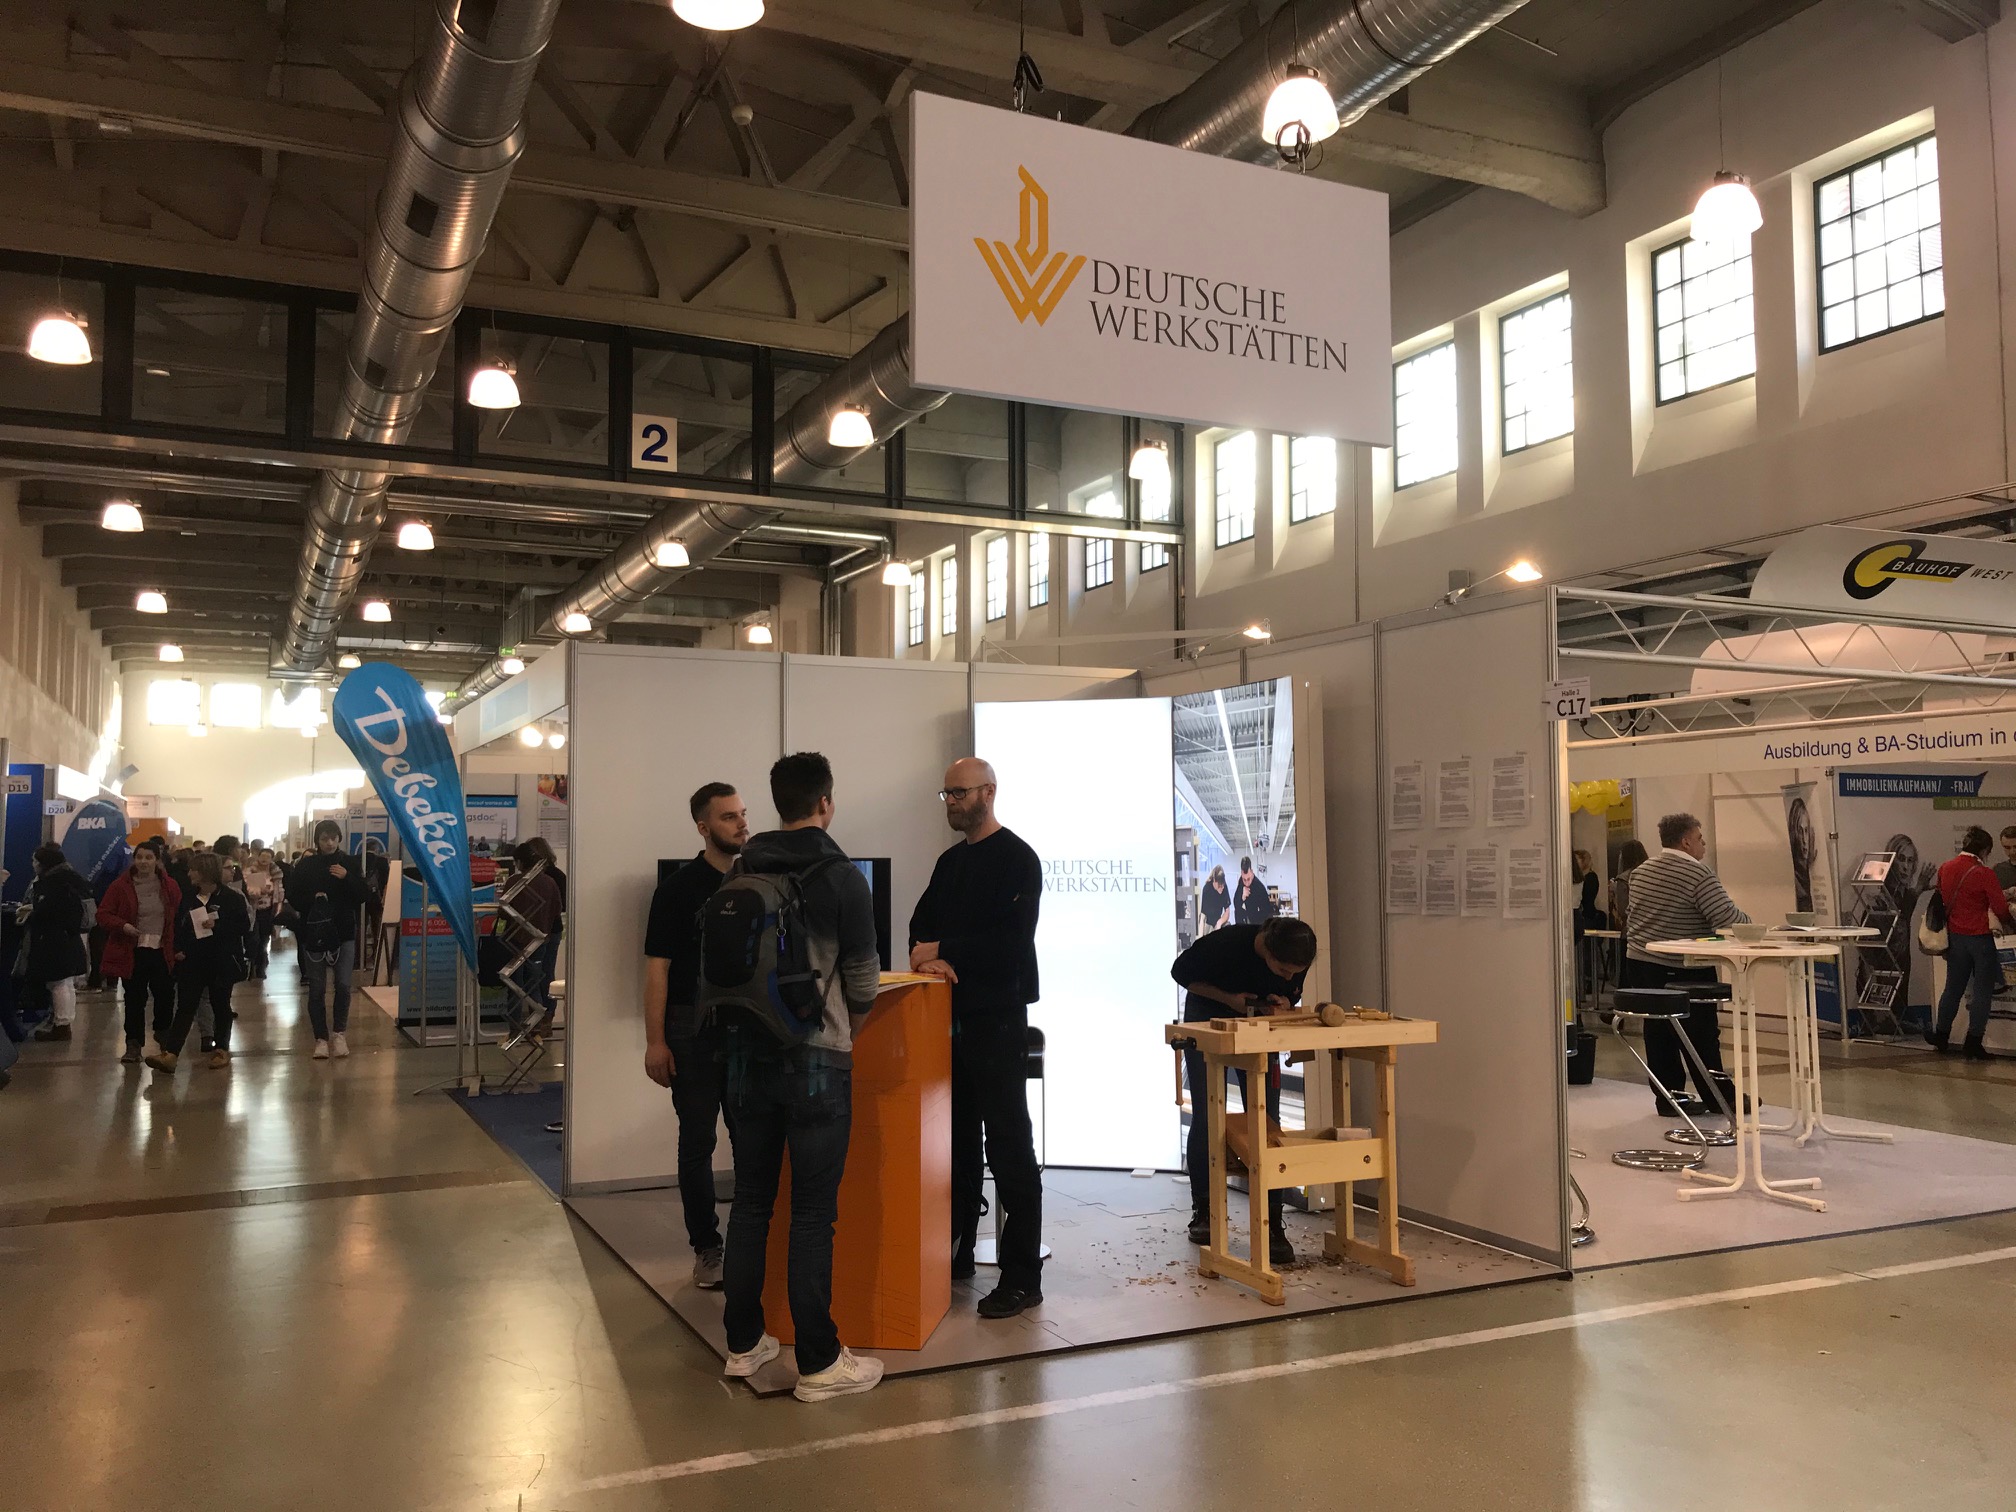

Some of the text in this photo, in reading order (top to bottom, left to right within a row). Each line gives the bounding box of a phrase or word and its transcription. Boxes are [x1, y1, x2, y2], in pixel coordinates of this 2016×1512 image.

[1091, 258, 1287, 325] DEUTSCHE
[1088, 299, 1348, 374] WERKSTÄTTEN
[641, 423, 669, 464] 2
[1892, 560, 2015, 581] BAUHOF WEST
[1561, 688, 1580, 697] Halle 2
[1556, 697, 1586, 717] C17
[1763, 740, 1852, 760] Ausbildung
[1857, 736, 1870, 754] &
[1875, 730, 1983, 753] BA-Studium
[1990, 727, 2007, 745] in
[353, 685, 458, 869] Debeka
[1846, 777, 1975, 794] IMMOBILIENKAUFMANN/ -FRAU
[8, 784, 30, 793] D19
[48, 806, 65, 814] D20
[77, 816, 107, 830] BKA
[1041, 859, 1134, 875] DEUTSCHE
[1042, 876, 1167, 893] WERKSTÄTTEN
